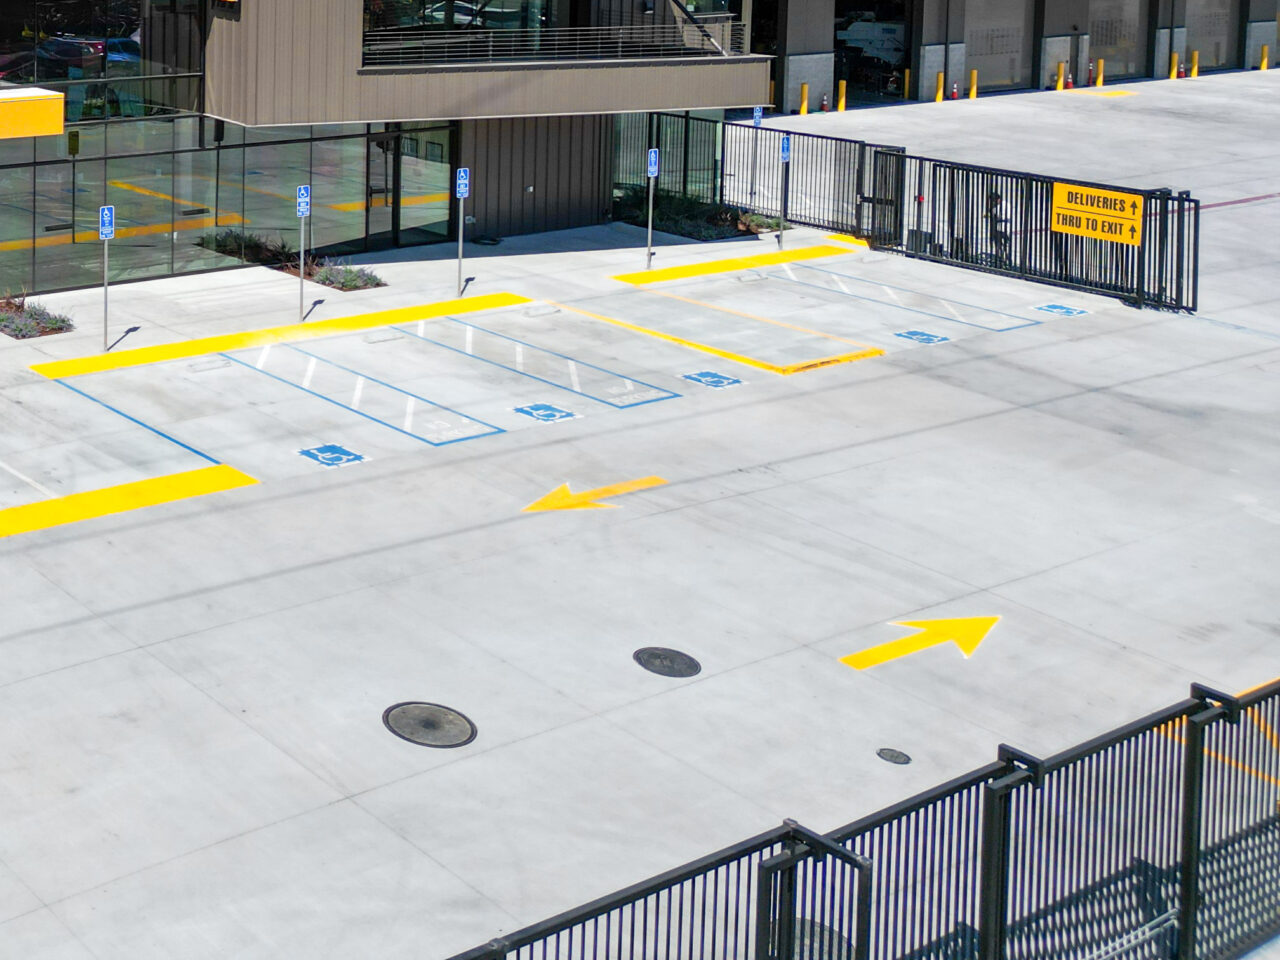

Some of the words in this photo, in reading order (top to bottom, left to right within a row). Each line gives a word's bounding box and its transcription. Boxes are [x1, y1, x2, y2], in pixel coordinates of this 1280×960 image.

[1067, 191, 1126, 212] DELIVERIES
[1056, 212, 1082, 228] THRU
[1085, 217, 1098, 231] TO
[1101, 220, 1124, 236] EXIT
